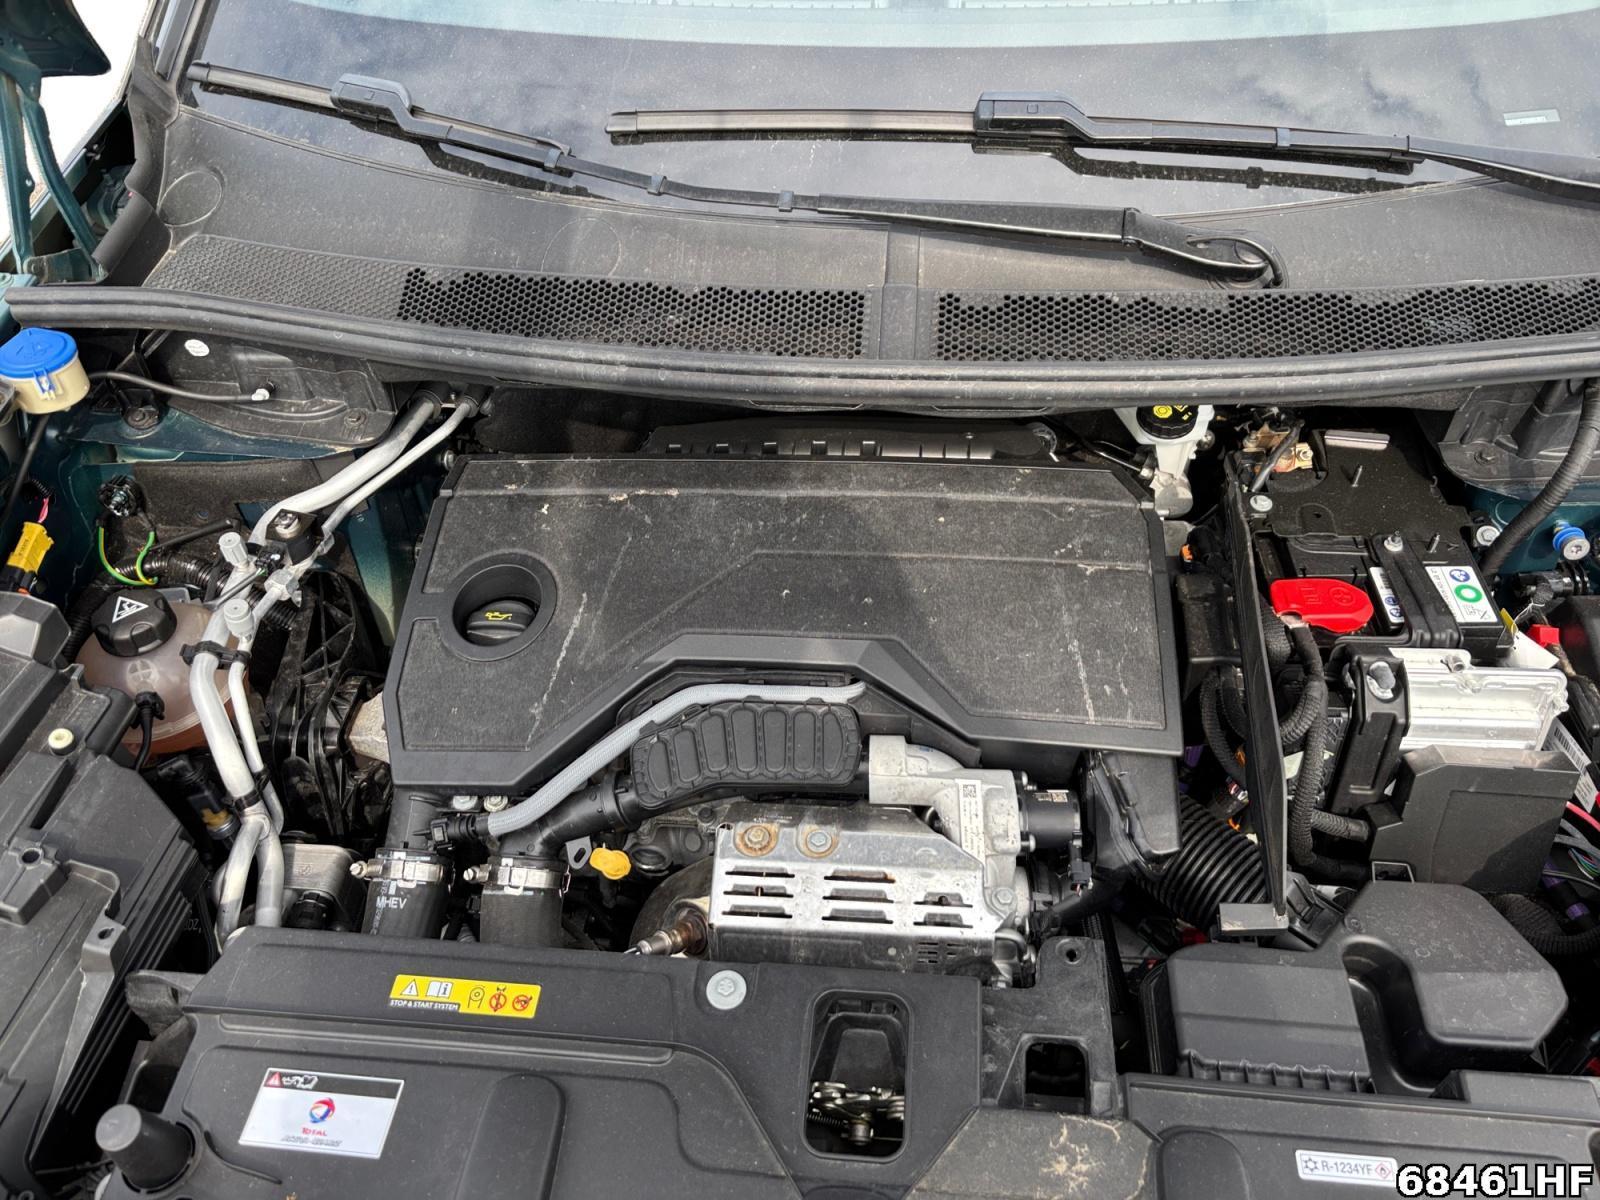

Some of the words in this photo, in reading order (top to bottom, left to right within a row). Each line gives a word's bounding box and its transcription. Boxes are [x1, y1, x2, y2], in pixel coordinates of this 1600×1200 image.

[375, 896, 407, 909] MHEV
[390, 999, 407, 1007] STOP
[414, 1001, 433, 1009] START
[1320, 1160, 1373, 1175] R-1234YF
